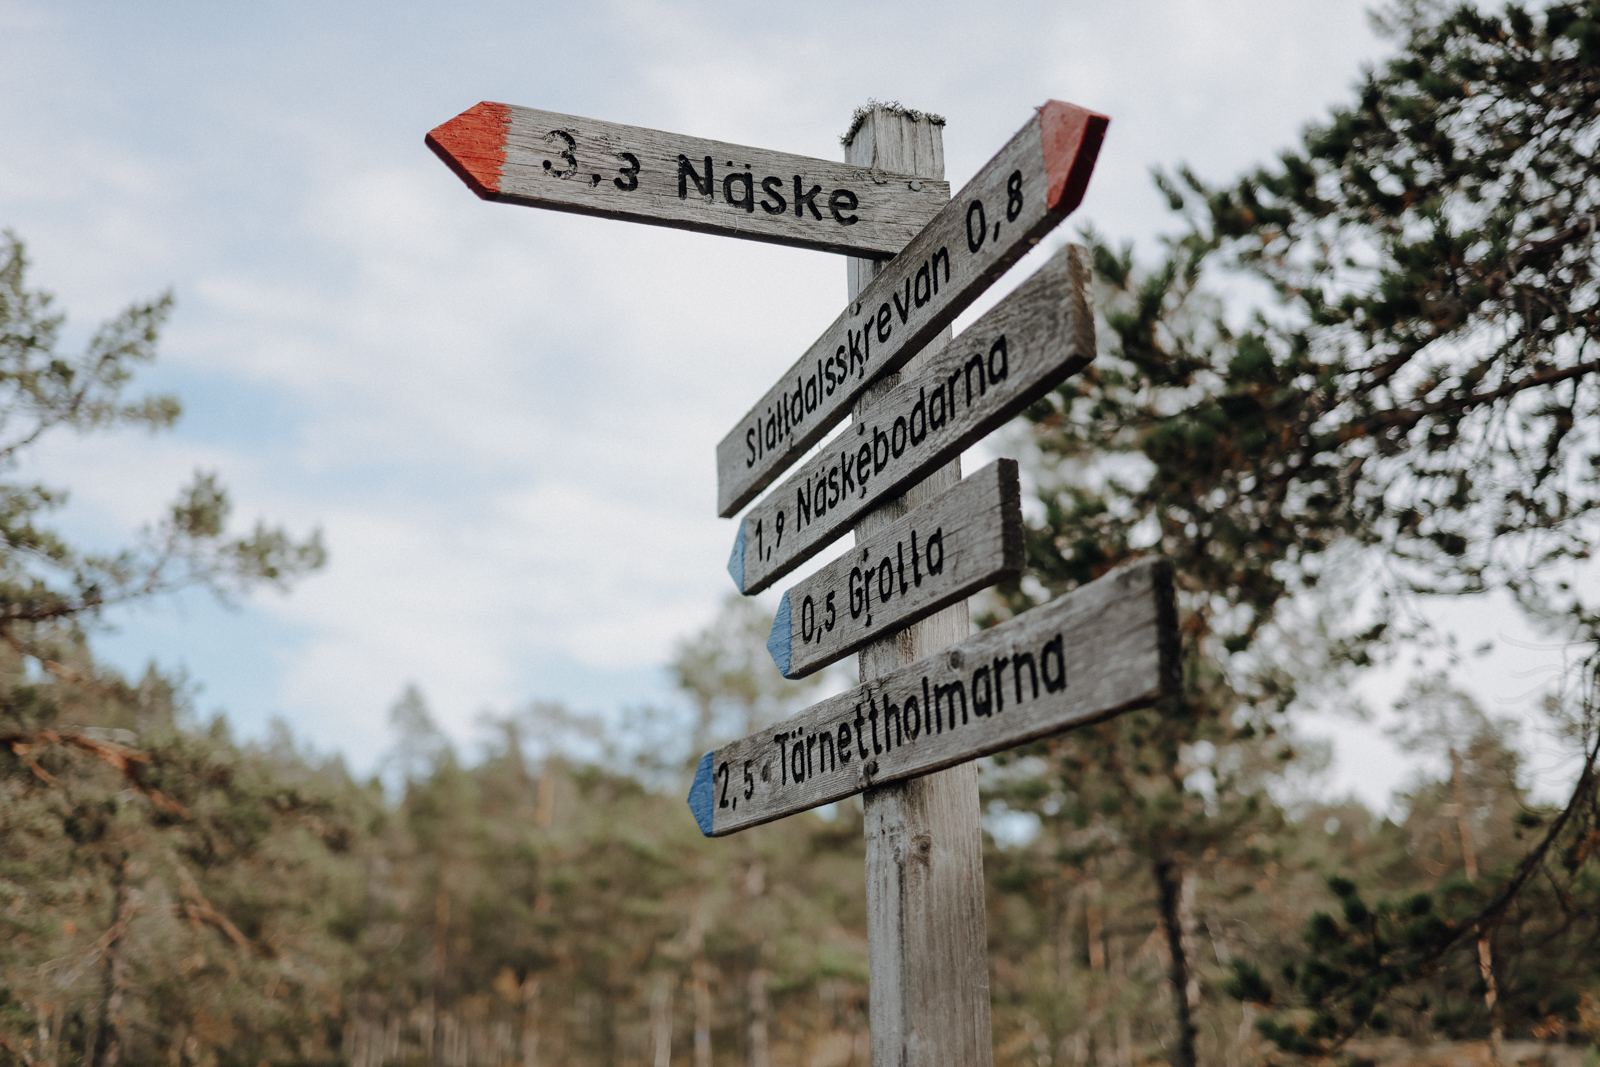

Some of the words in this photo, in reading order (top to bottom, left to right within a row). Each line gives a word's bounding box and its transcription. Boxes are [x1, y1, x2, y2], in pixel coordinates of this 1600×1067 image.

[541, 129, 641, 192] 3,3
[676, 153, 860, 226] Näske
[965, 169, 1023, 254] 0,8
[754, 510, 785, 562] 1,9
[797, 333, 1009, 532] Näskebodarna
[801, 589, 836, 644] 0,5
[849, 527, 944, 619] Grotta
[717, 759, 754, 810] 2,5
[773, 632, 1067, 786] Tärnettholmarna
